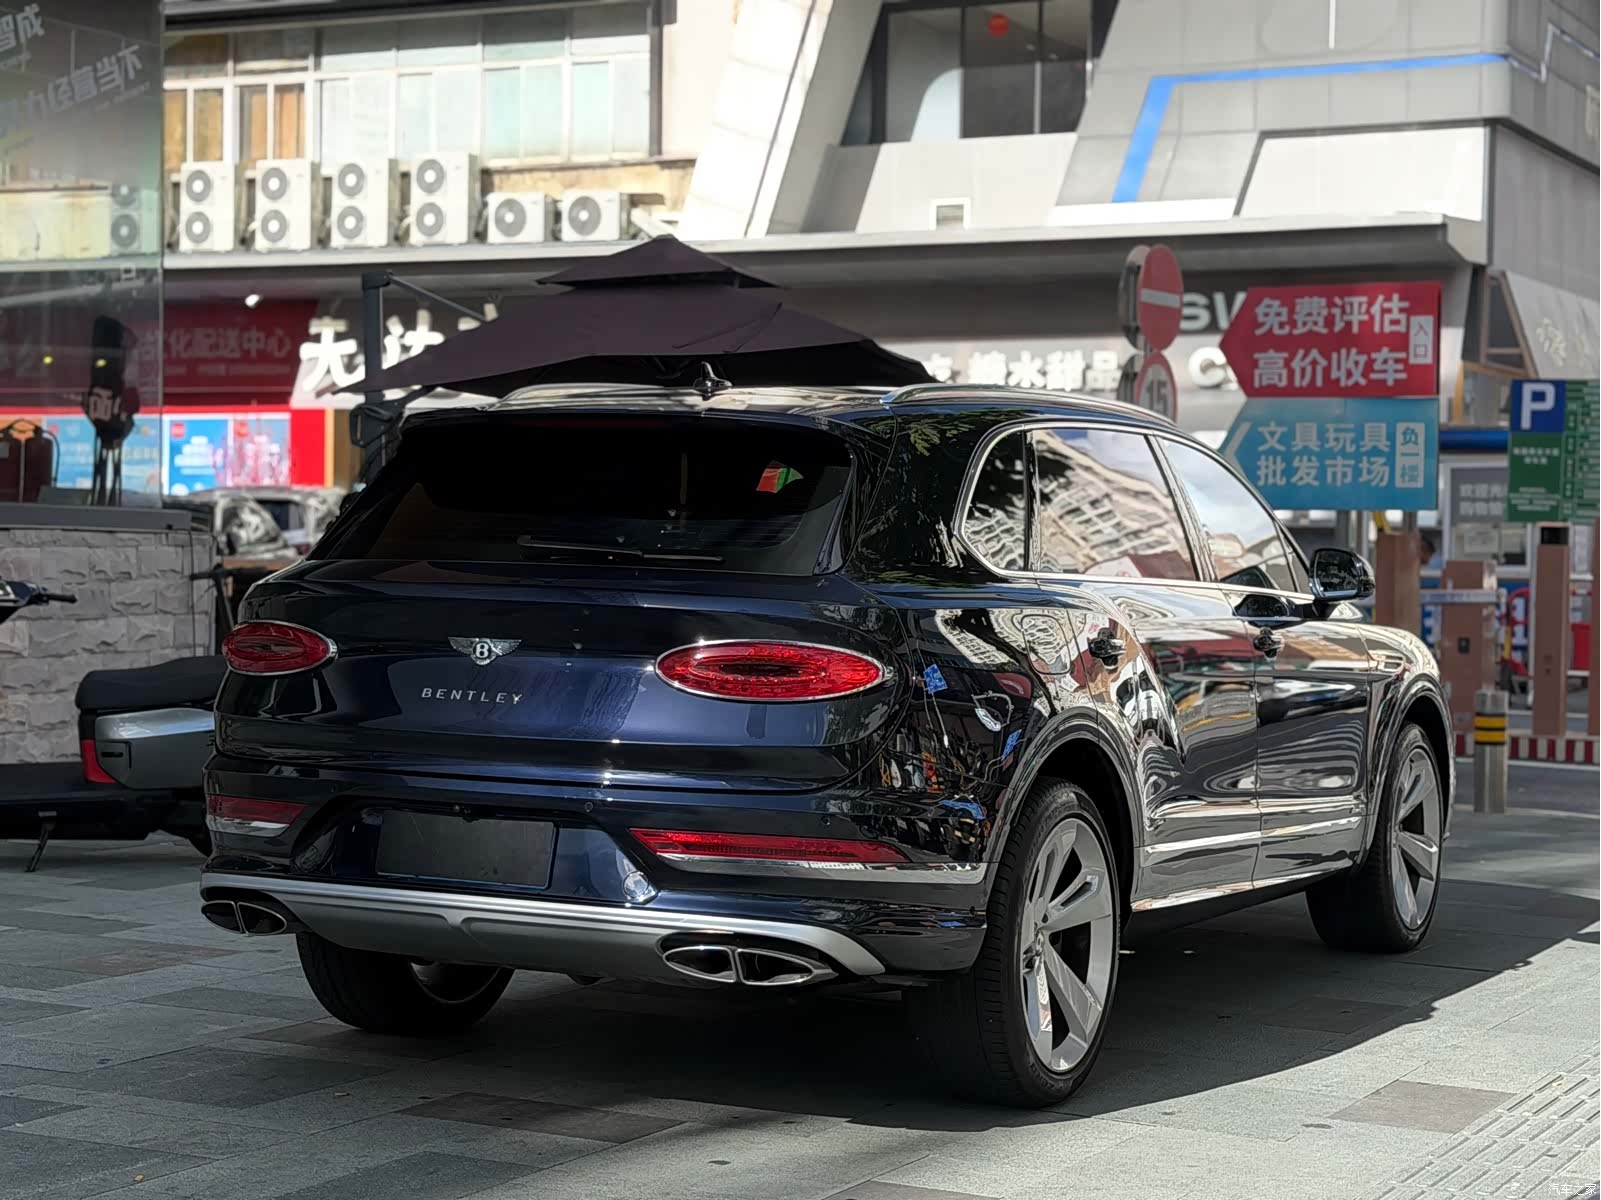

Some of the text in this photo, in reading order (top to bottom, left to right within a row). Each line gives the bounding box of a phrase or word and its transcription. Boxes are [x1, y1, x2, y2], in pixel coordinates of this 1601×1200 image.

[1254, 293, 1410, 336] 免费评估
[1412, 321, 1429, 359] 入口
[1252, 347, 1408, 389] 高价收车
[1520, 382, 1556, 431] P
[1257, 421, 1391, 453] 文具玩具
[1256, 456, 1389, 487] 批发市场
[475, 642, 490, 659] B
[421, 687, 523, 705] BENTLEY
